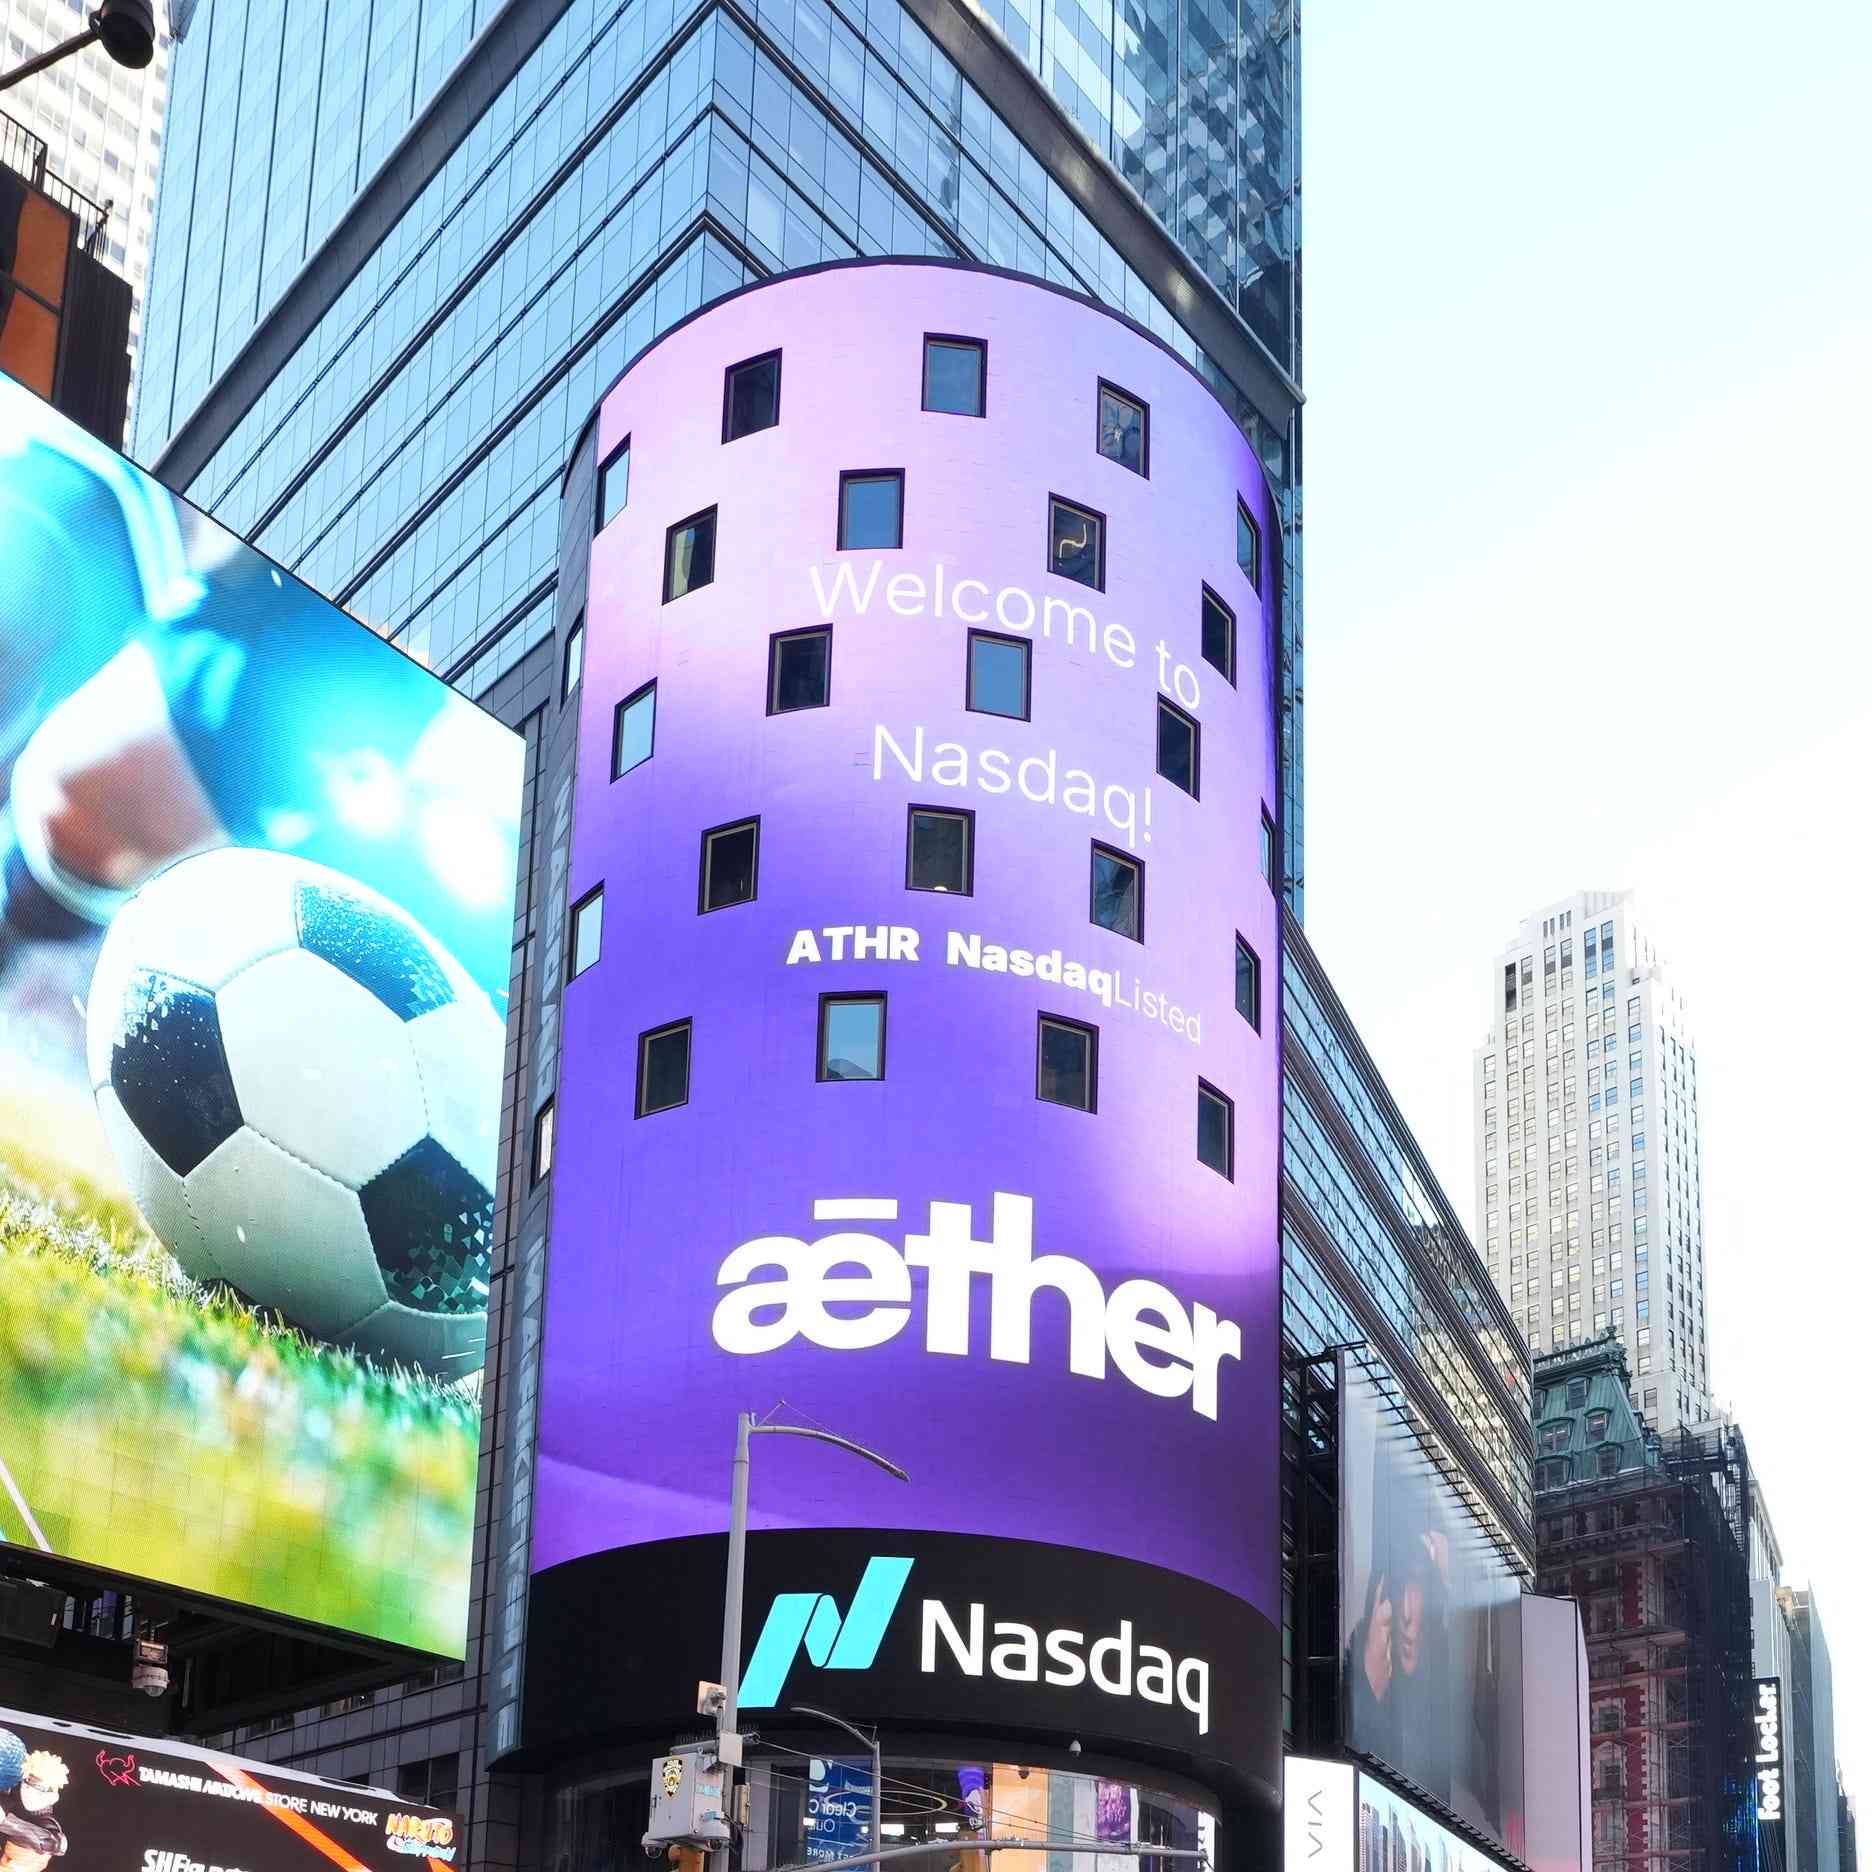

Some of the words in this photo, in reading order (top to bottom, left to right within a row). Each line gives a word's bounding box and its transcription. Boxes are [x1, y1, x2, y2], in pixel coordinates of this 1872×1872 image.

[808, 558, 1137, 670] Welcome
[1155, 637, 1204, 711] to
[871, 724, 1155, 846] Nasdaq!
[785, 925, 922, 965] ATHR
[920, 1597, 1210, 1734] Nasdaq
[265, 1787, 308, 1813] STORE
[310, 1799, 341, 1818] NEW
[341, 1805, 378, 1827] YORK
[1758, 1767, 1781, 1820] Foot
